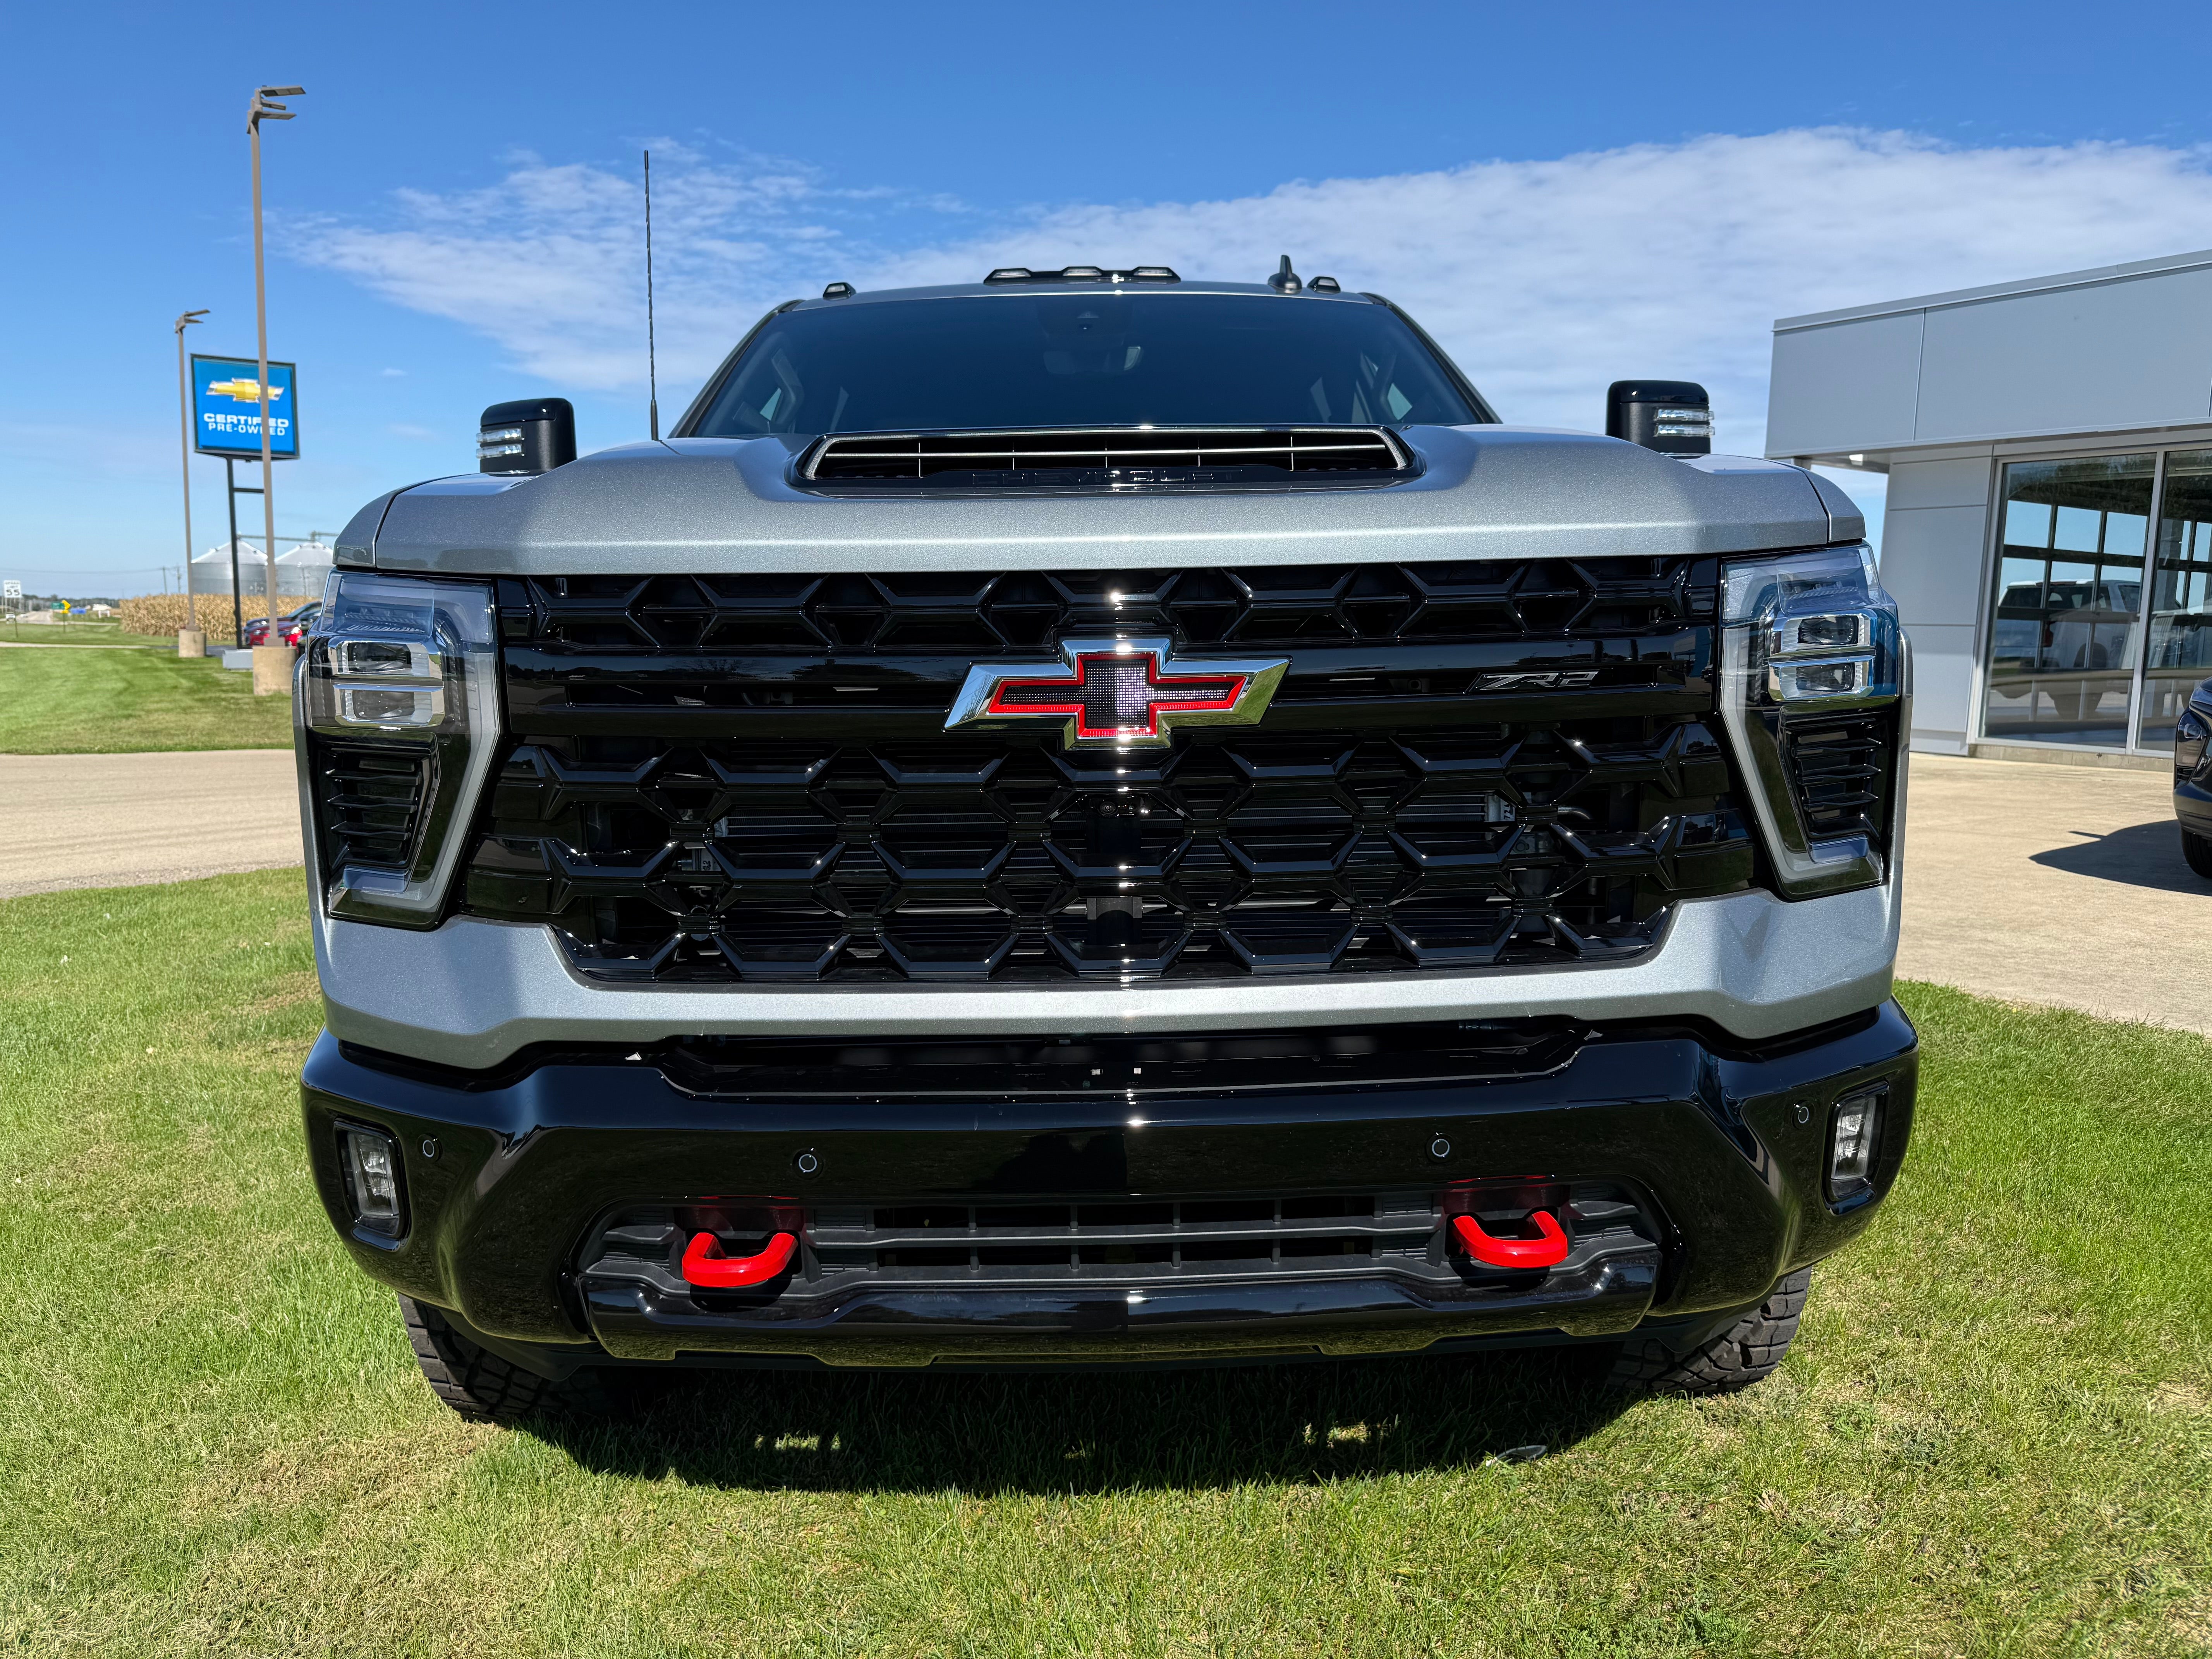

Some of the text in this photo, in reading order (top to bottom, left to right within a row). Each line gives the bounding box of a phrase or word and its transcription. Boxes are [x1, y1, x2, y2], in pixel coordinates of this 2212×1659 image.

[204, 413, 289, 428] CERTIFED
[208, 422, 285, 436] PRE-OWED
[972, 469, 1243, 484] CHEVROLET
[1479, 672, 1599, 690] ZR2
